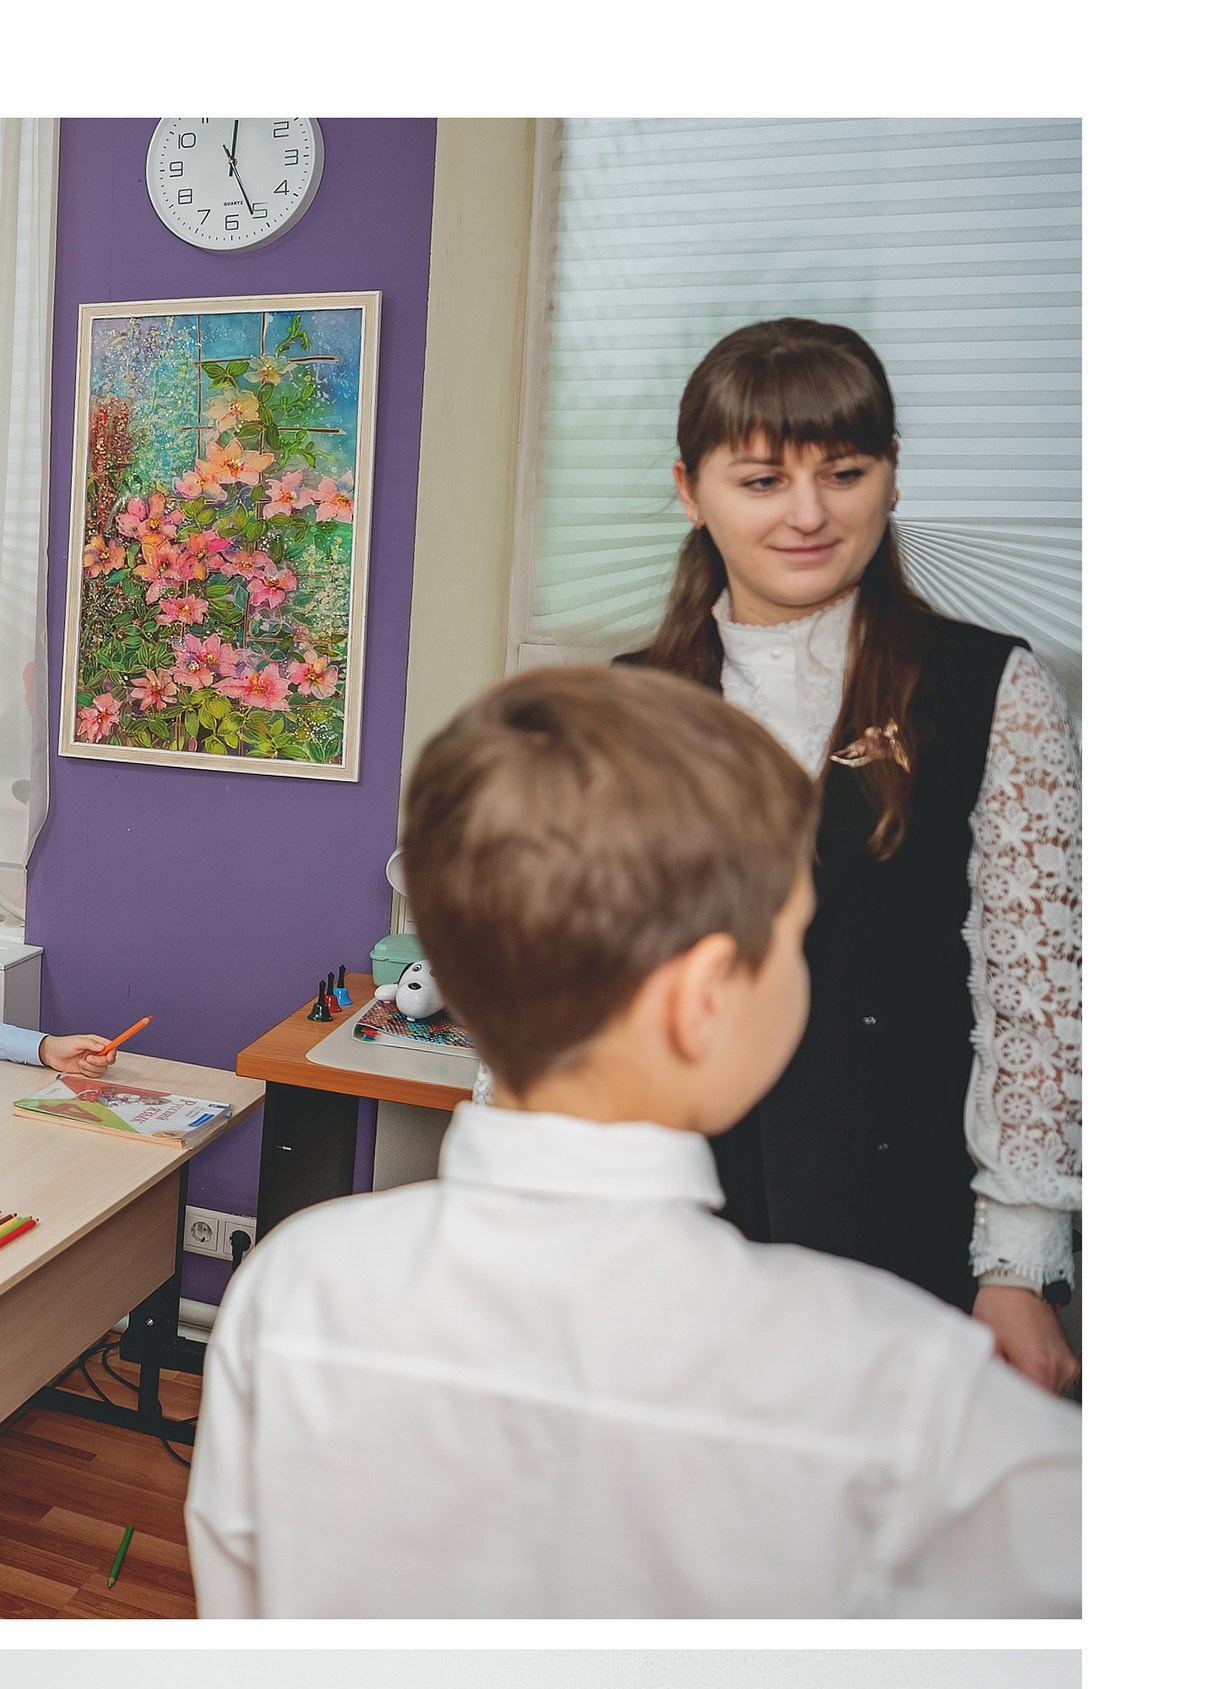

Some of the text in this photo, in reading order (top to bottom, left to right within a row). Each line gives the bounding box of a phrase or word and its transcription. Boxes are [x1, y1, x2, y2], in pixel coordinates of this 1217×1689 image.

[274, 122, 289, 138] 2
[178, 132, 196, 149] 10
[284, 150, 298, 166] 3
[170, 161, 183, 177] 9
[274, 180, 289, 195] 4
[178, 189, 192, 204] 8
[197, 210, 210, 225] 7
[252, 203, 268, 219] 5
[225, 215, 239, 230] 6
